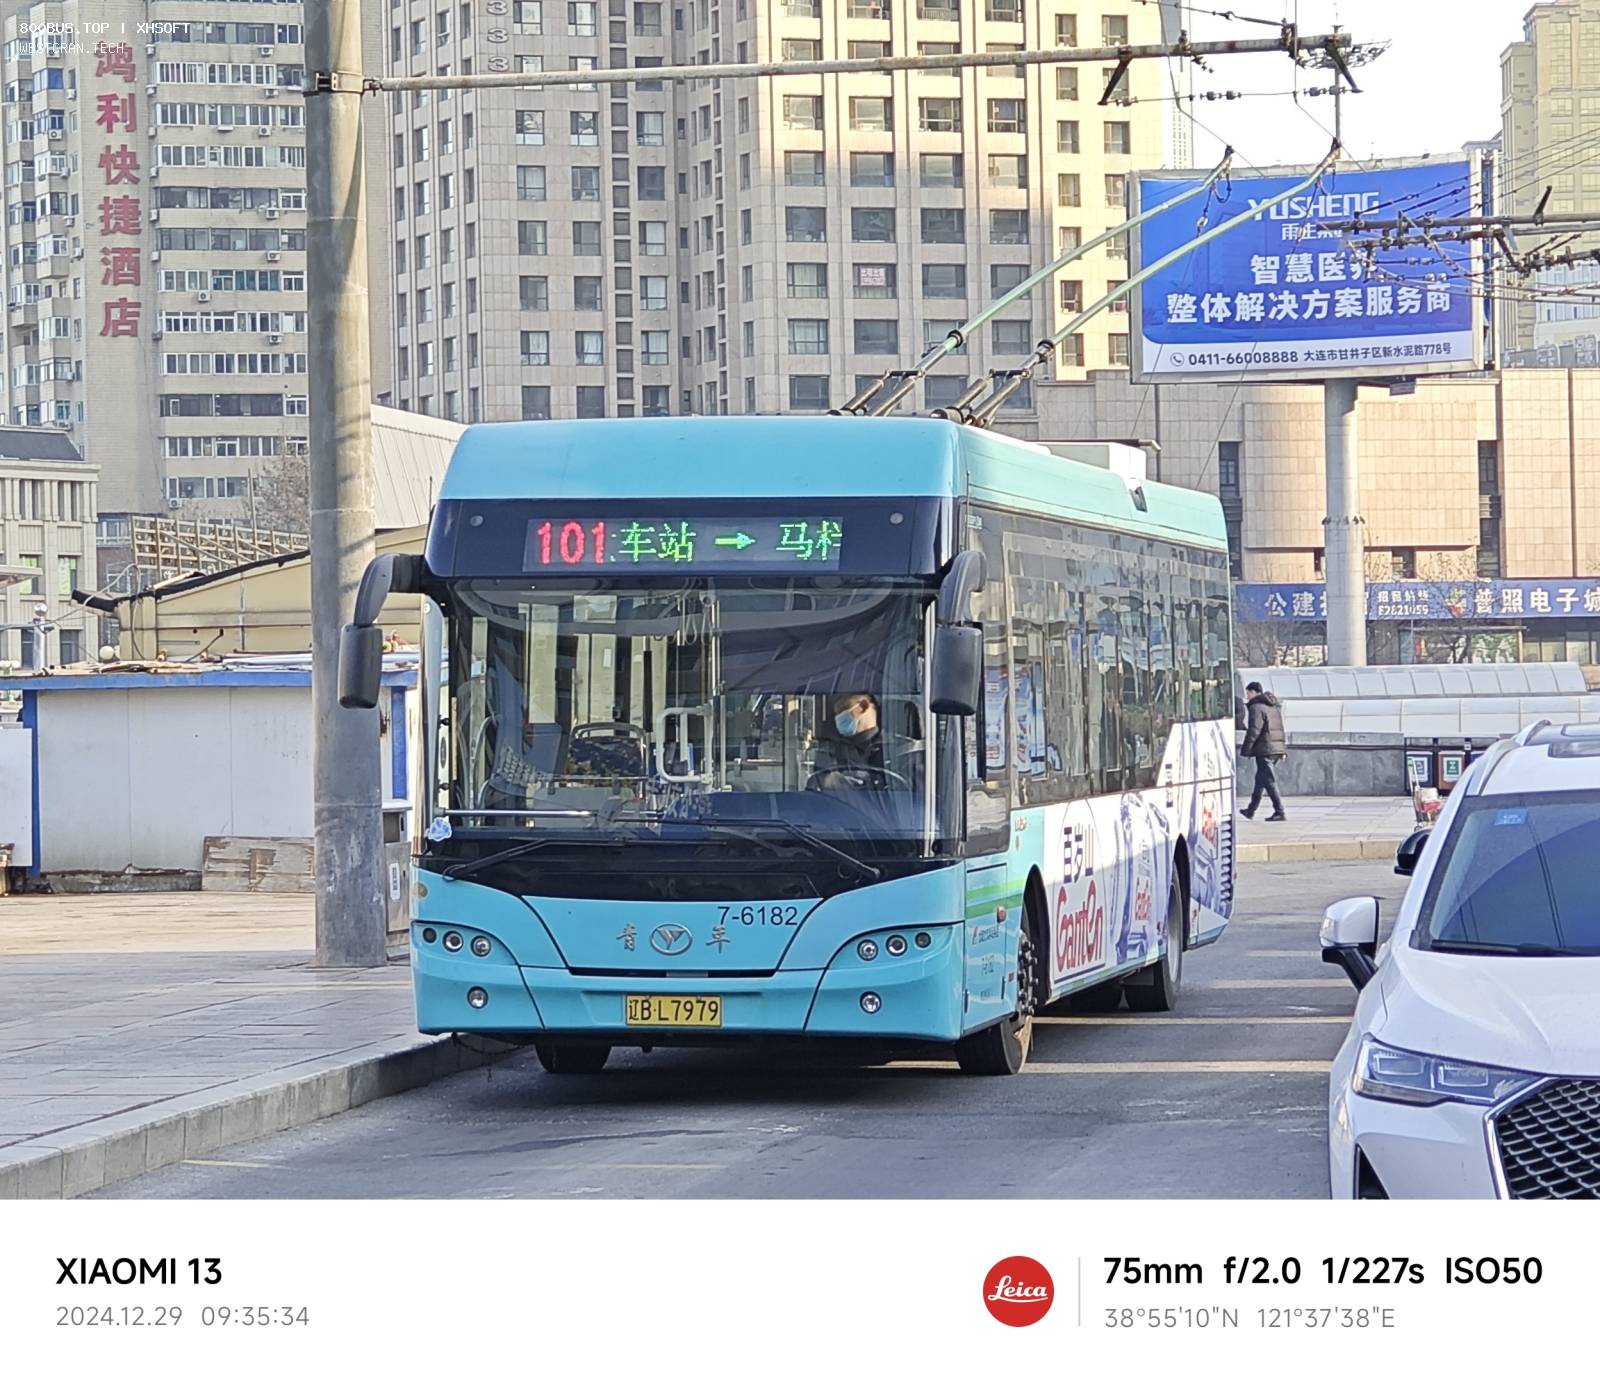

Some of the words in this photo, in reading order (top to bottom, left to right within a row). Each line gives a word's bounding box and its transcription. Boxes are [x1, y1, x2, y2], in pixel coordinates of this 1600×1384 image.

[95, 41, 142, 338] 鸿利快捷酒店
[1166, 283, 1451, 324] 整体解决方案服务商
[1188, 351, 1299, 366] 0411-66008888
[1303, 342, 1452, 362] 大连市甘井子区新水泥路778号
[537, 520, 605, 566] 101
[1264, 591, 1369, 618] 公建
[717, 906, 798, 926] 7-6182
